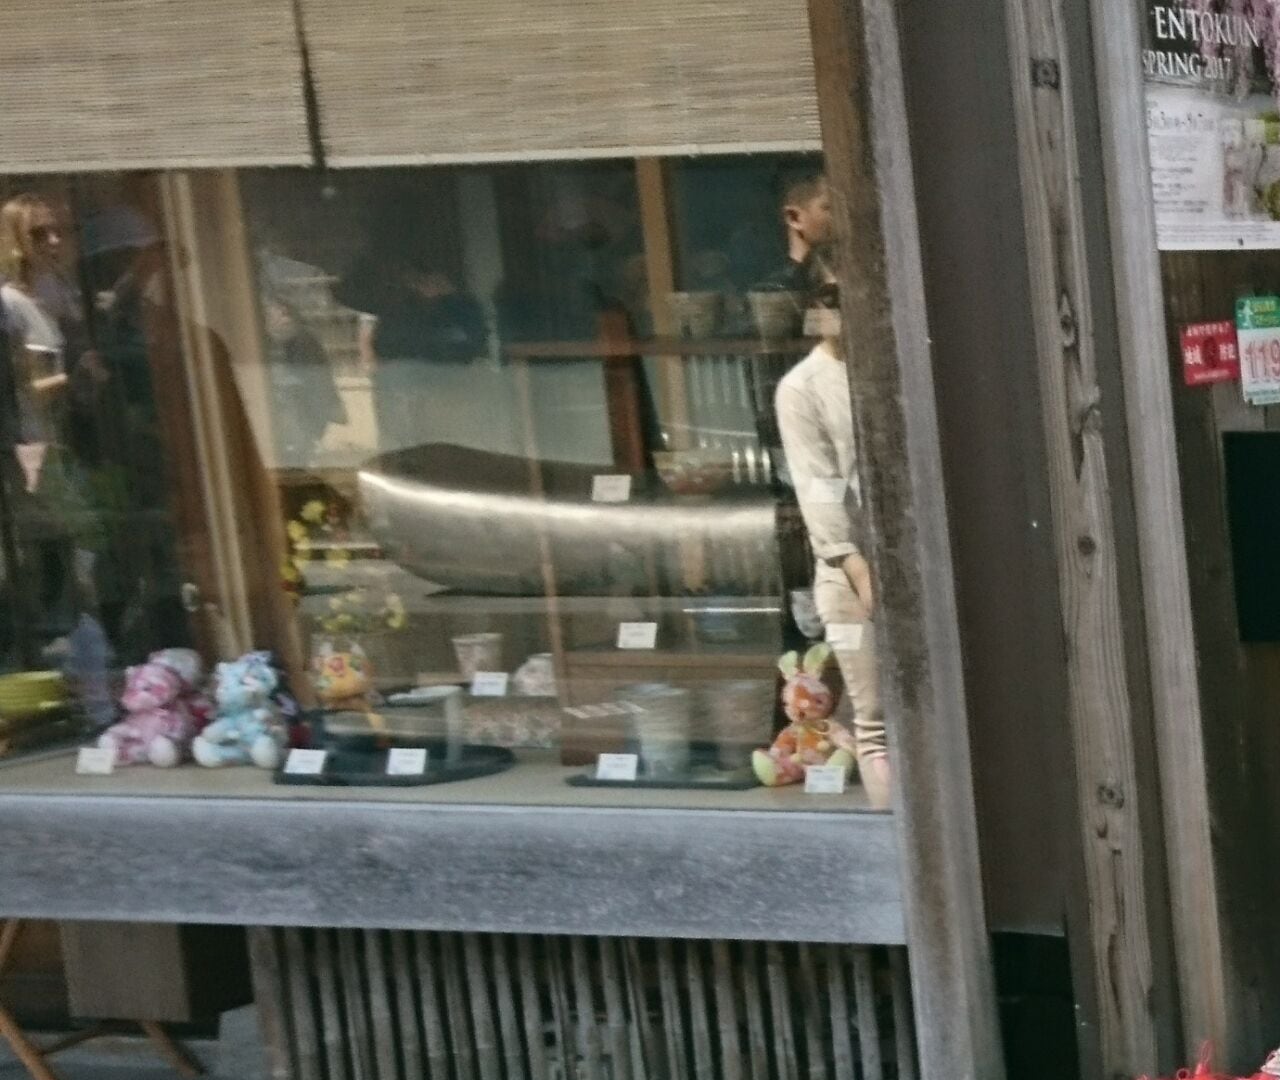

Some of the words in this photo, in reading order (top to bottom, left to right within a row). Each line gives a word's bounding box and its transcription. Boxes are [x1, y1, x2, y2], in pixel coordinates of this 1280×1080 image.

[1153, 6, 1260, 47] ENTOKUIN
[1142, 49, 1202, 80] SPRING
[1204, 56, 1231, 80] 2017
